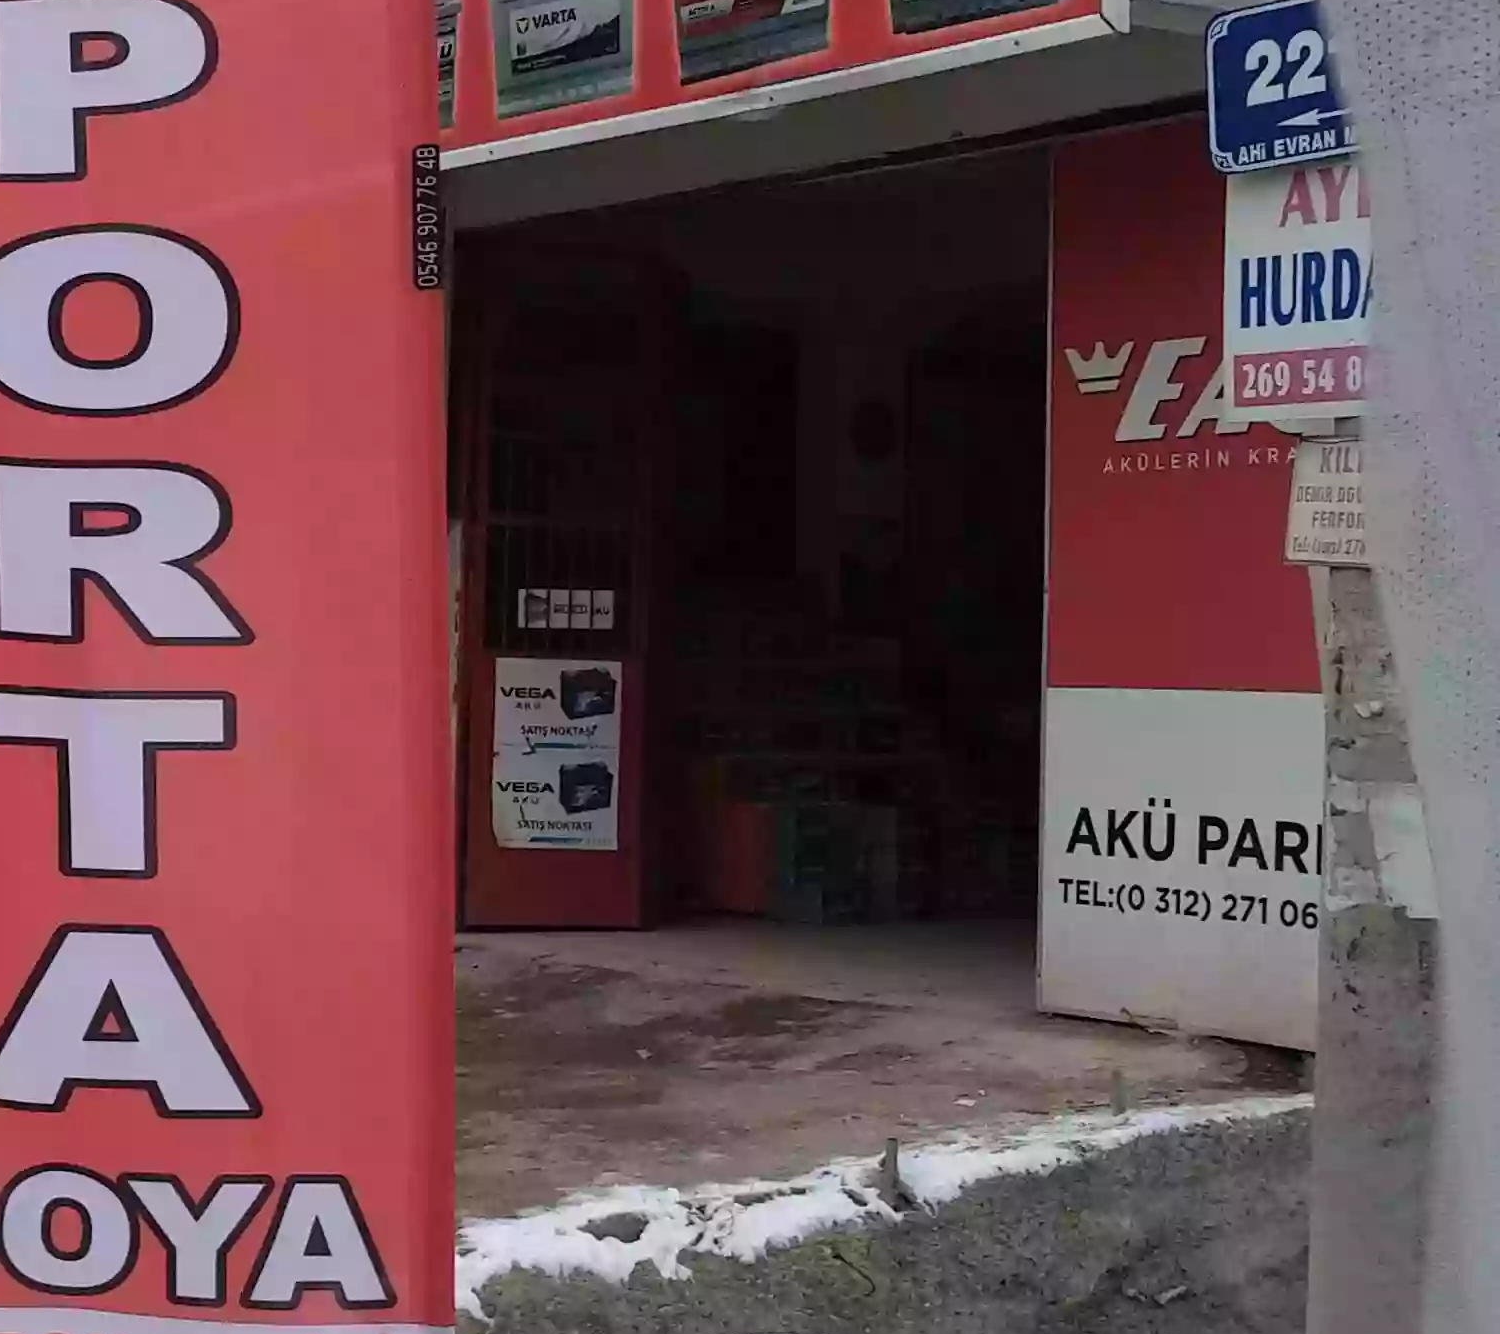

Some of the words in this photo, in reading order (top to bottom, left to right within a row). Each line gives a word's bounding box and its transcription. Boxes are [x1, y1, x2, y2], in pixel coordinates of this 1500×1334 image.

[532, 7, 577, 29] VARTA
[1244, 29, 1336, 108] 22
[1274, 128, 1336, 158] EVRAN
[416, 175, 437, 198] 76
[417, 204, 438, 236] 907
[417, 241, 438, 287] 0546
[1242, 361, 1291, 399] 269
[1302, 359, 1335, 395] 54
[1102, 449, 1230, 474] AKÜLERİN
[500, 687, 557, 700] VEGA
[520, 724, 549, 737] SATIŞ
[497, 781, 555, 794] VEGA
[517, 819, 545, 832] SATIŞ
[548, 820, 593, 832] NOKTASI
[1065, 797, 1176, 862] AKÜ
[1058, 878, 1145, 913] TEL:(0
[1155, 887, 1211, 922] 312)
[1222, 894, 1268, 925] 271
[1279, 900, 1319, 929] 06
